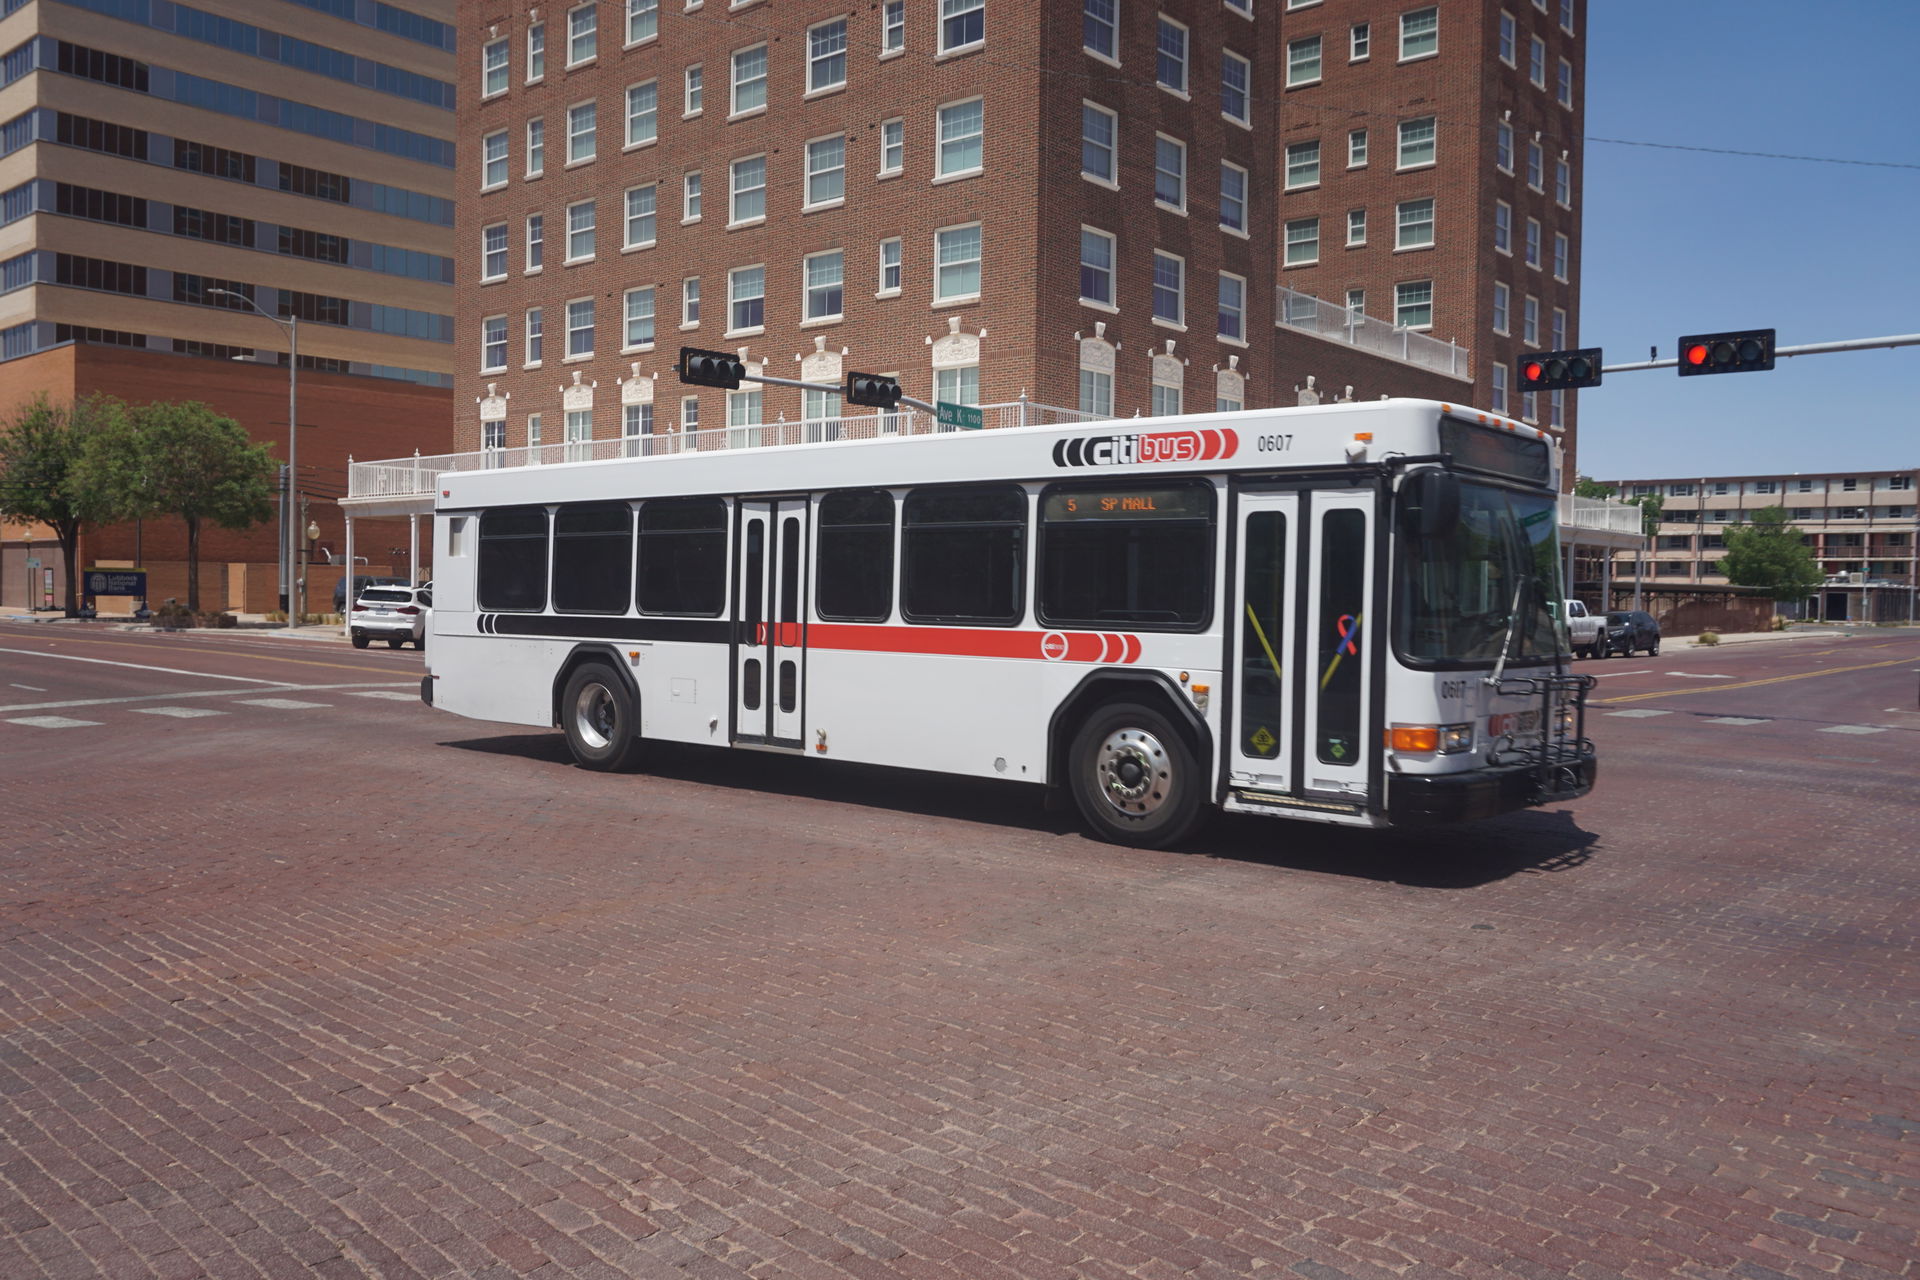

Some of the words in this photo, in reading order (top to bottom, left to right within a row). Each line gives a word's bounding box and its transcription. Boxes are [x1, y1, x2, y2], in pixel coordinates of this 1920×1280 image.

[939, 406, 953, 422] Ave
[956, 408, 963, 424] K
[1093, 434, 1195, 465] citibus
[1258, 434, 1293, 452] 0607
[1067, 498, 1077, 512] 5
[1100, 497, 1118, 511] SP
[1122, 496, 1157, 510] MALL
